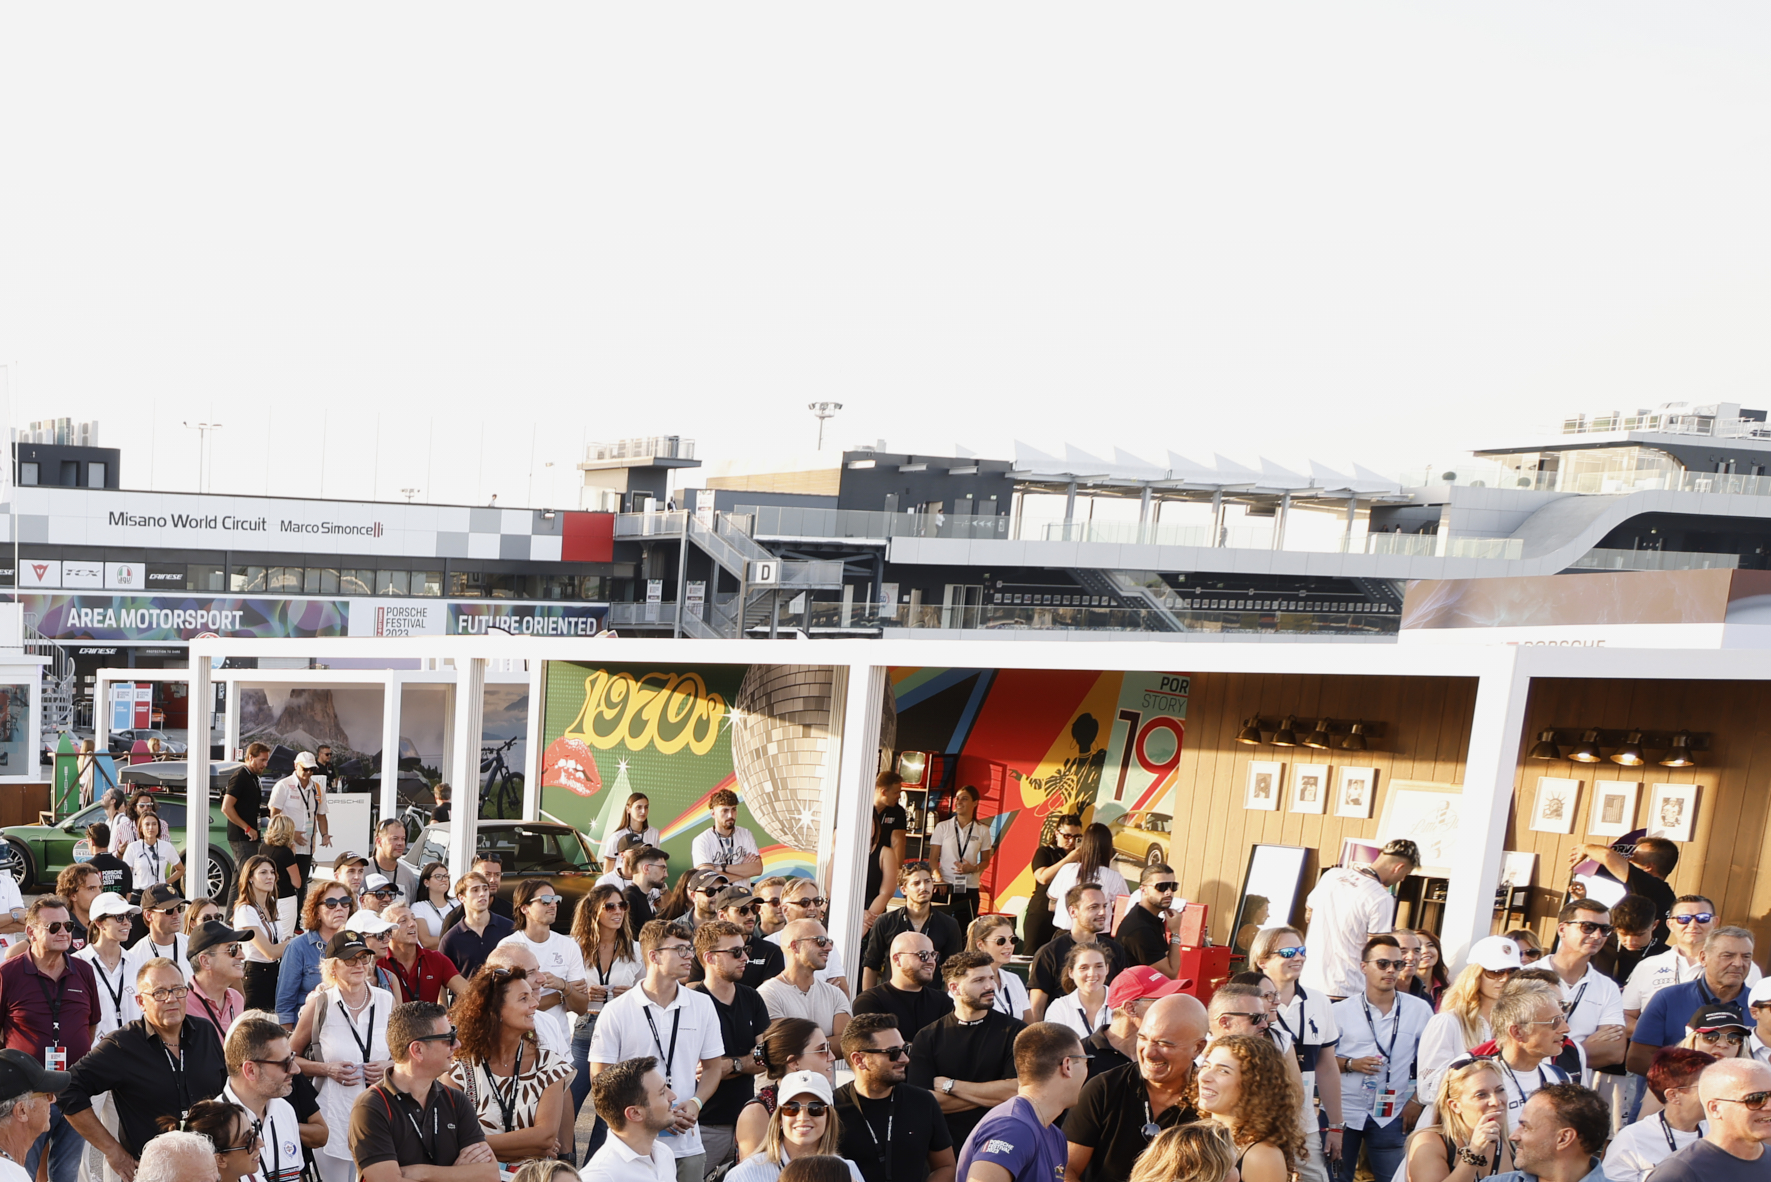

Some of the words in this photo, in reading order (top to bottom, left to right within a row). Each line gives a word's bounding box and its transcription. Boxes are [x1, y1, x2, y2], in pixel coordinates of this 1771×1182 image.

[108, 511, 167, 528] Misano
[171, 514, 217, 530] World
[222, 516, 267, 532] Circuit
[280, 520, 320, 534] Marco
[320, 522, 384, 538] Simoncelli
[149, 572, 184, 581] DAINESE
[760, 564, 770, 580] D
[66, 608, 116, 628] AREA
[120, 608, 244, 630] MOTORSPORT
[386, 606, 428, 618] PORSCHE
[386, 618, 426, 629] FESTIVAL
[458, 614, 520, 634] FUTURE
[522, 616, 597, 636] ORIENTED
[1160, 676, 1190, 694] POR
[564, 668, 726, 756] 1970s
[1142, 693, 1186, 714] STORY
[1114, 708, 1186, 815] 19
[990, 1139, 1014, 1150] PORSCHE
